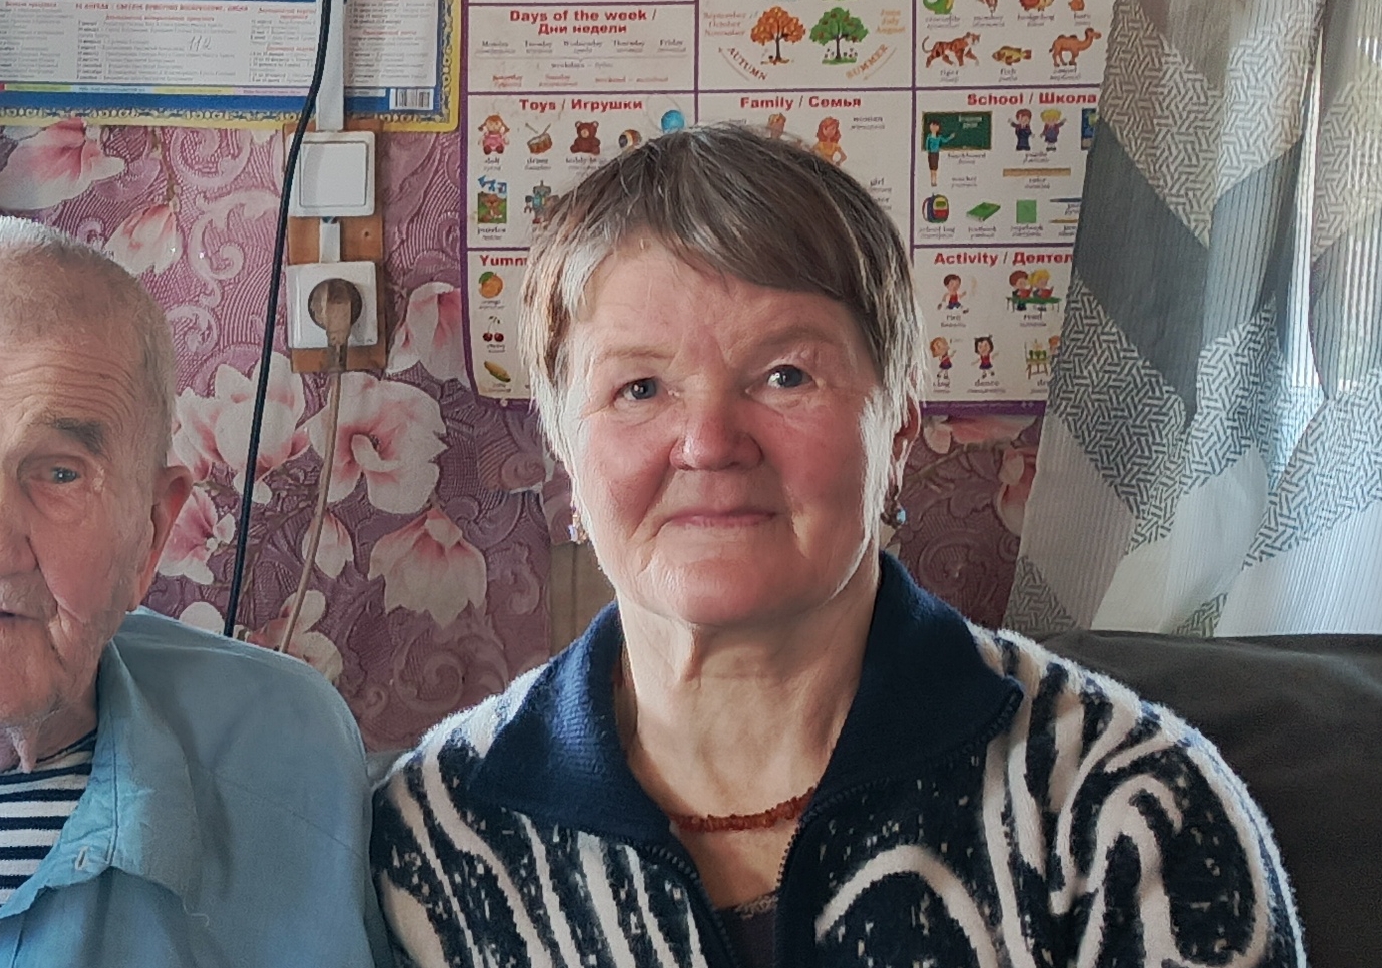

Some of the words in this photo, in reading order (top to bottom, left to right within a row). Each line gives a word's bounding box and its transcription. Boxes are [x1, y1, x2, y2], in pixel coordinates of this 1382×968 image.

[510, 10, 548, 24] Days
[553, 10, 568, 22] of
[574, 10, 599, 21] the
[604, 9, 647, 21] week
[538, 23, 568, 35] Дни
[572, 24, 627, 35] недели
[519, 99, 556, 112] Toys
[571, 98, 643, 112] Игрушки
[740, 96, 793, 111] Family
[808, 96, 861, 108] Семья
[967, 93, 1024, 106] School
[1038, 92, 1097, 105] Школа
[480, 254, 528, 267] Yumm
[934, 252, 998, 267] Activity
[1012, 252, 1073, 265] Деятел
